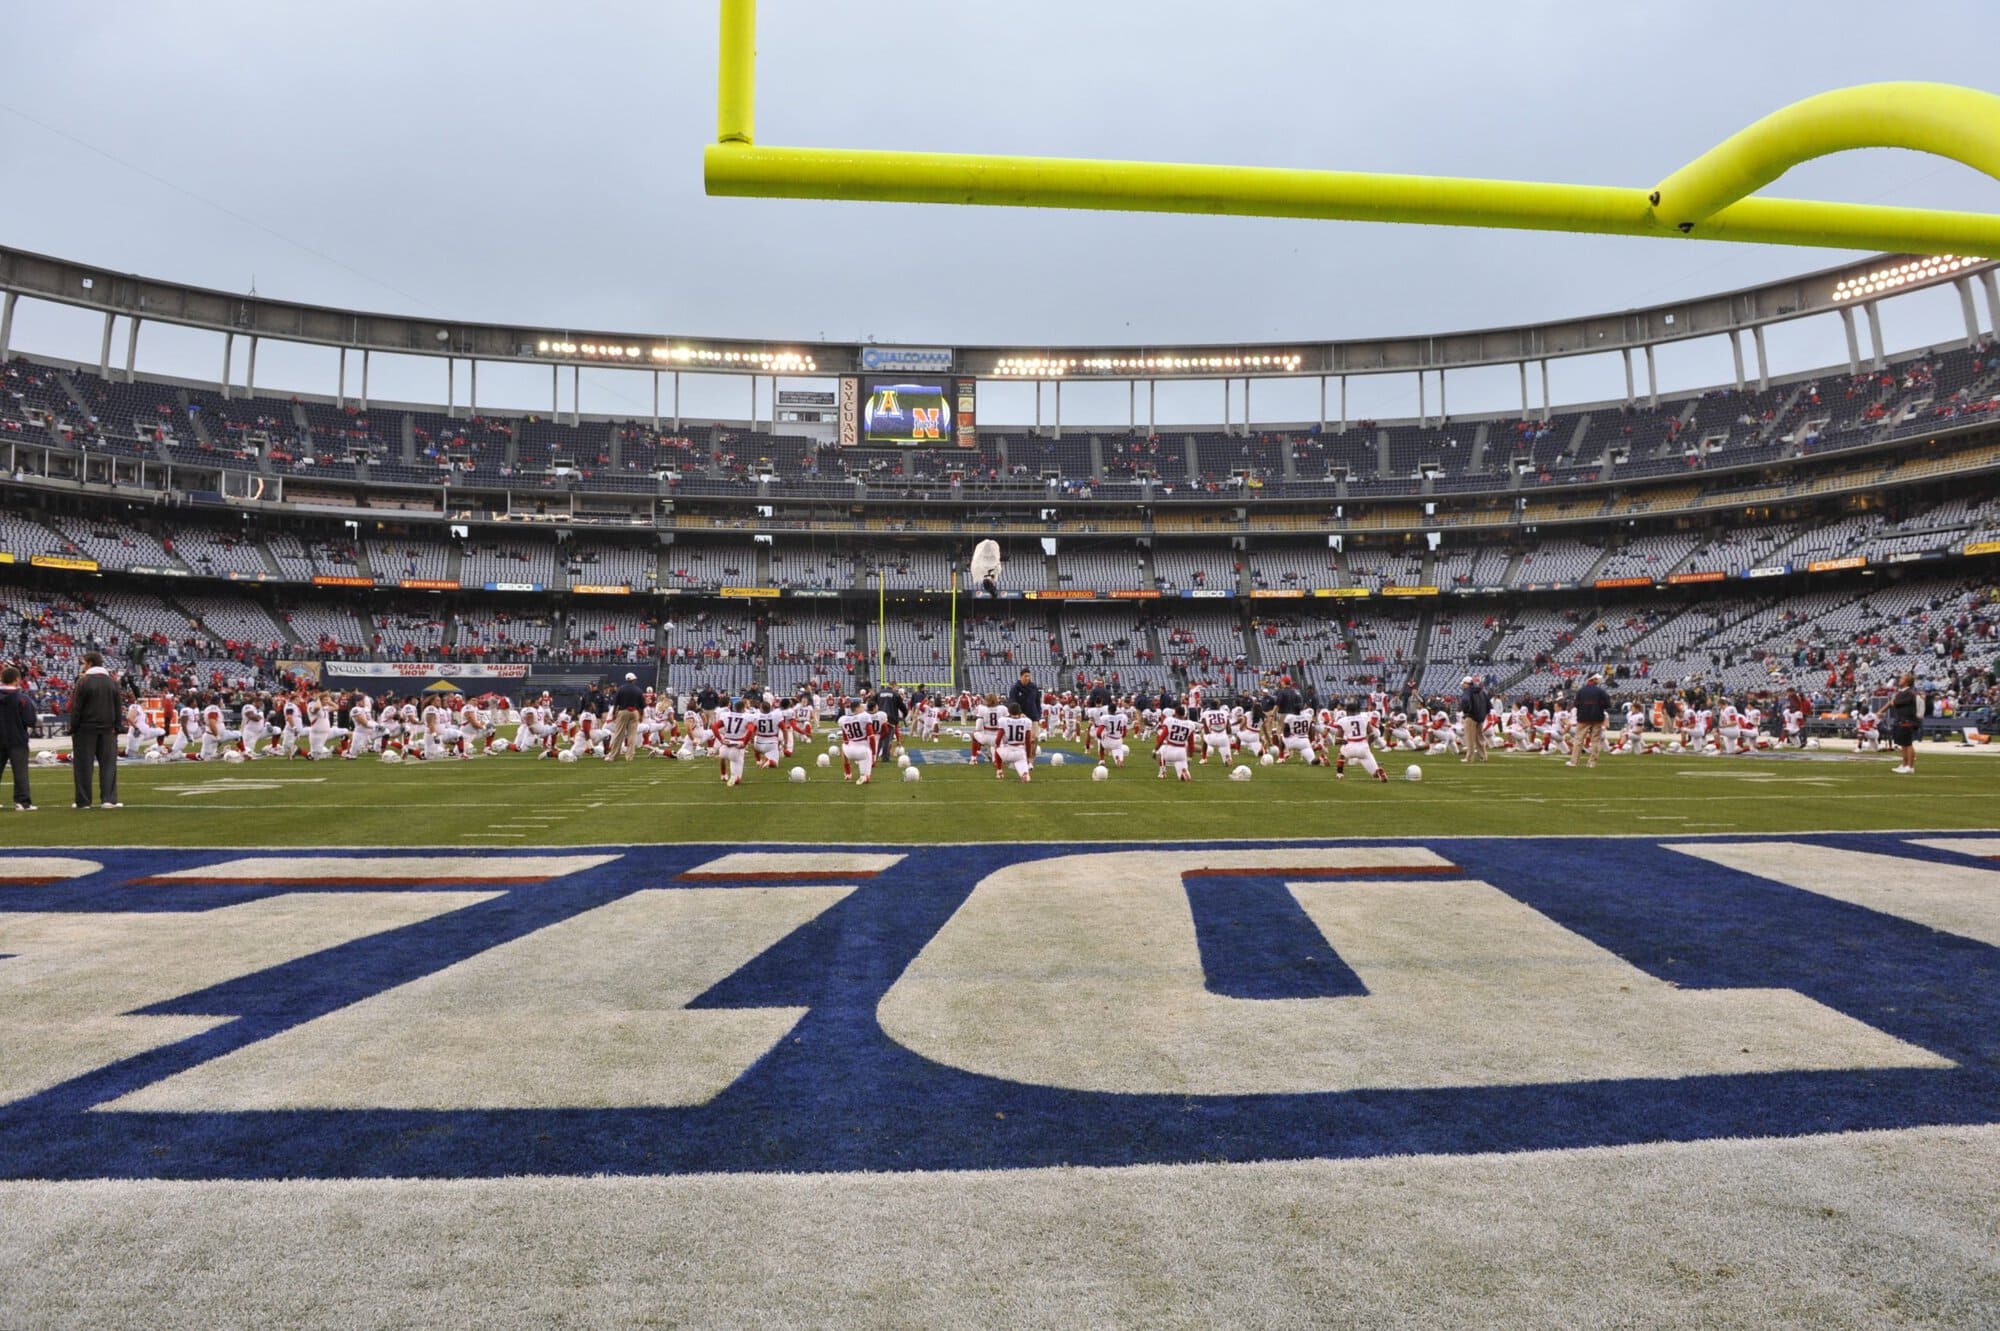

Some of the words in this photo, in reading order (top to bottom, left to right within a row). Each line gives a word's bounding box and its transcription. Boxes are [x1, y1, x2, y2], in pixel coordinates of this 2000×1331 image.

[864, 349, 950, 368] QUALCOMM
[843, 380, 854, 443] SYCUAN
[874, 391, 903, 418] A
[912, 408, 939, 438] N
[1815, 558, 1857, 571] CYMER
[1595, 579, 1623, 587] WELLS
[1192, 590, 1225, 598] GEICO
[328, 664, 366, 673] SYCUAN
[727, 717, 744, 734] 17
[758, 719, 774, 734] 61
[990, 712, 998, 727] 8
[1208, 713, 1225, 725] 26
[844, 720, 863, 739] 38
[1008, 725, 1025, 742] 16
[1109, 720, 1124, 735] 14
[1170, 725, 1189, 741] 23
[1293, 720, 1309, 735] 28
[1350, 721, 1361, 737] 3
